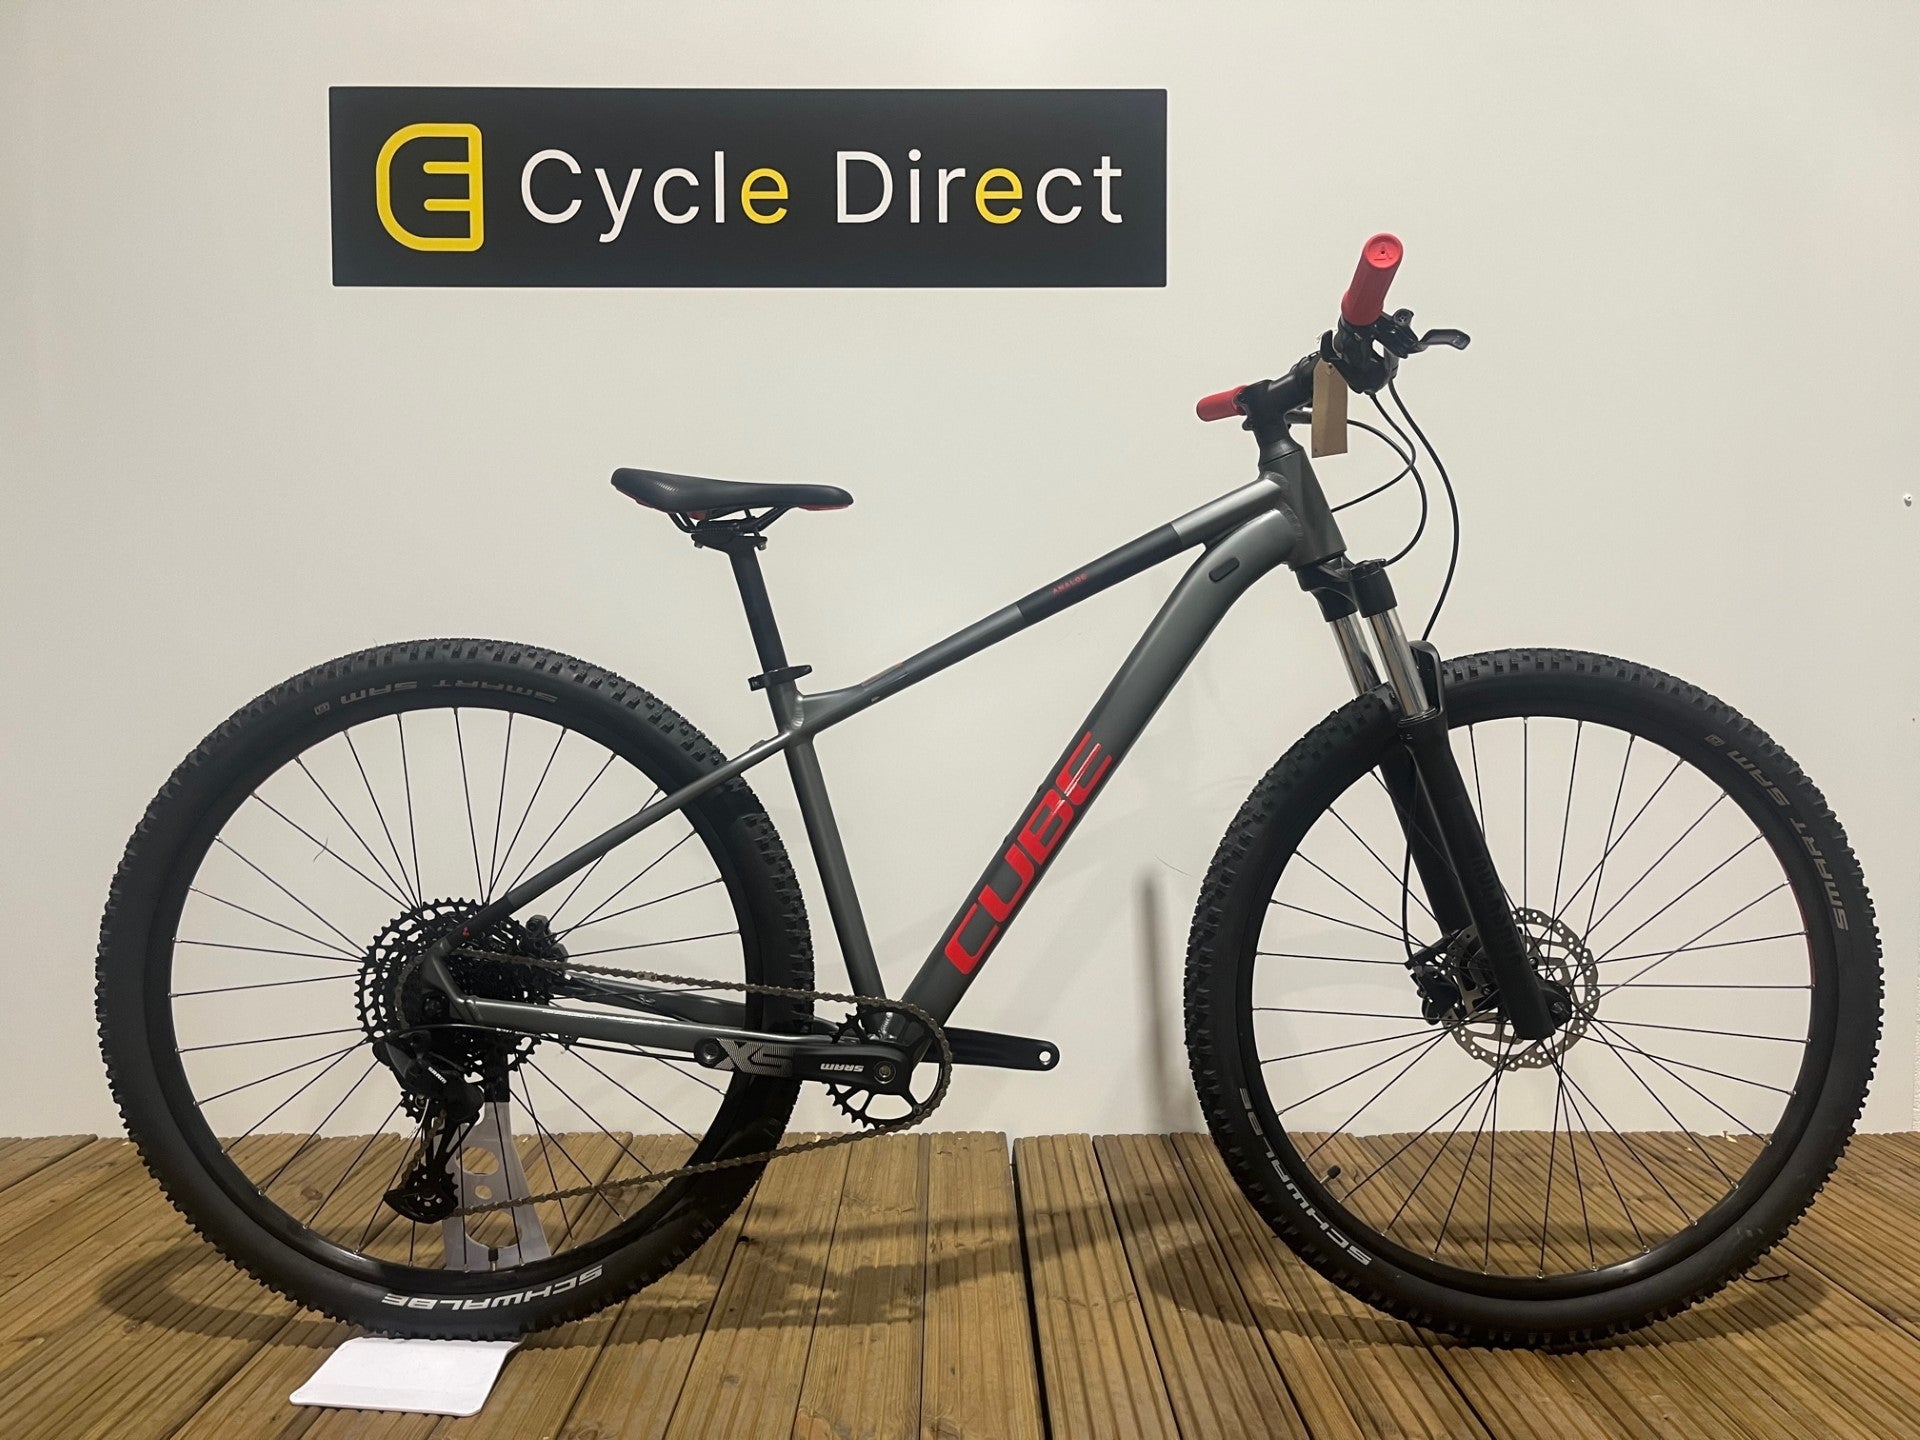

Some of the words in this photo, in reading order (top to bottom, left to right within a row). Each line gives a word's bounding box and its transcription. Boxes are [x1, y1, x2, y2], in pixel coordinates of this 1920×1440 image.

[521, 148, 790, 243] Cycle
[836, 148, 1123, 225] Direct
[340, 681, 417, 704] SAM
[432, 680, 558, 703] SMART
[1727, 750, 1790, 806] SAM
[944, 731, 1112, 975] CUBE
[1789, 817, 1849, 931] SMART
[820, 1063, 864, 1073] SRAM
[1240, 1088, 1372, 1266] SCHWALBE
[382, 1265, 603, 1311] SCHWALBE
